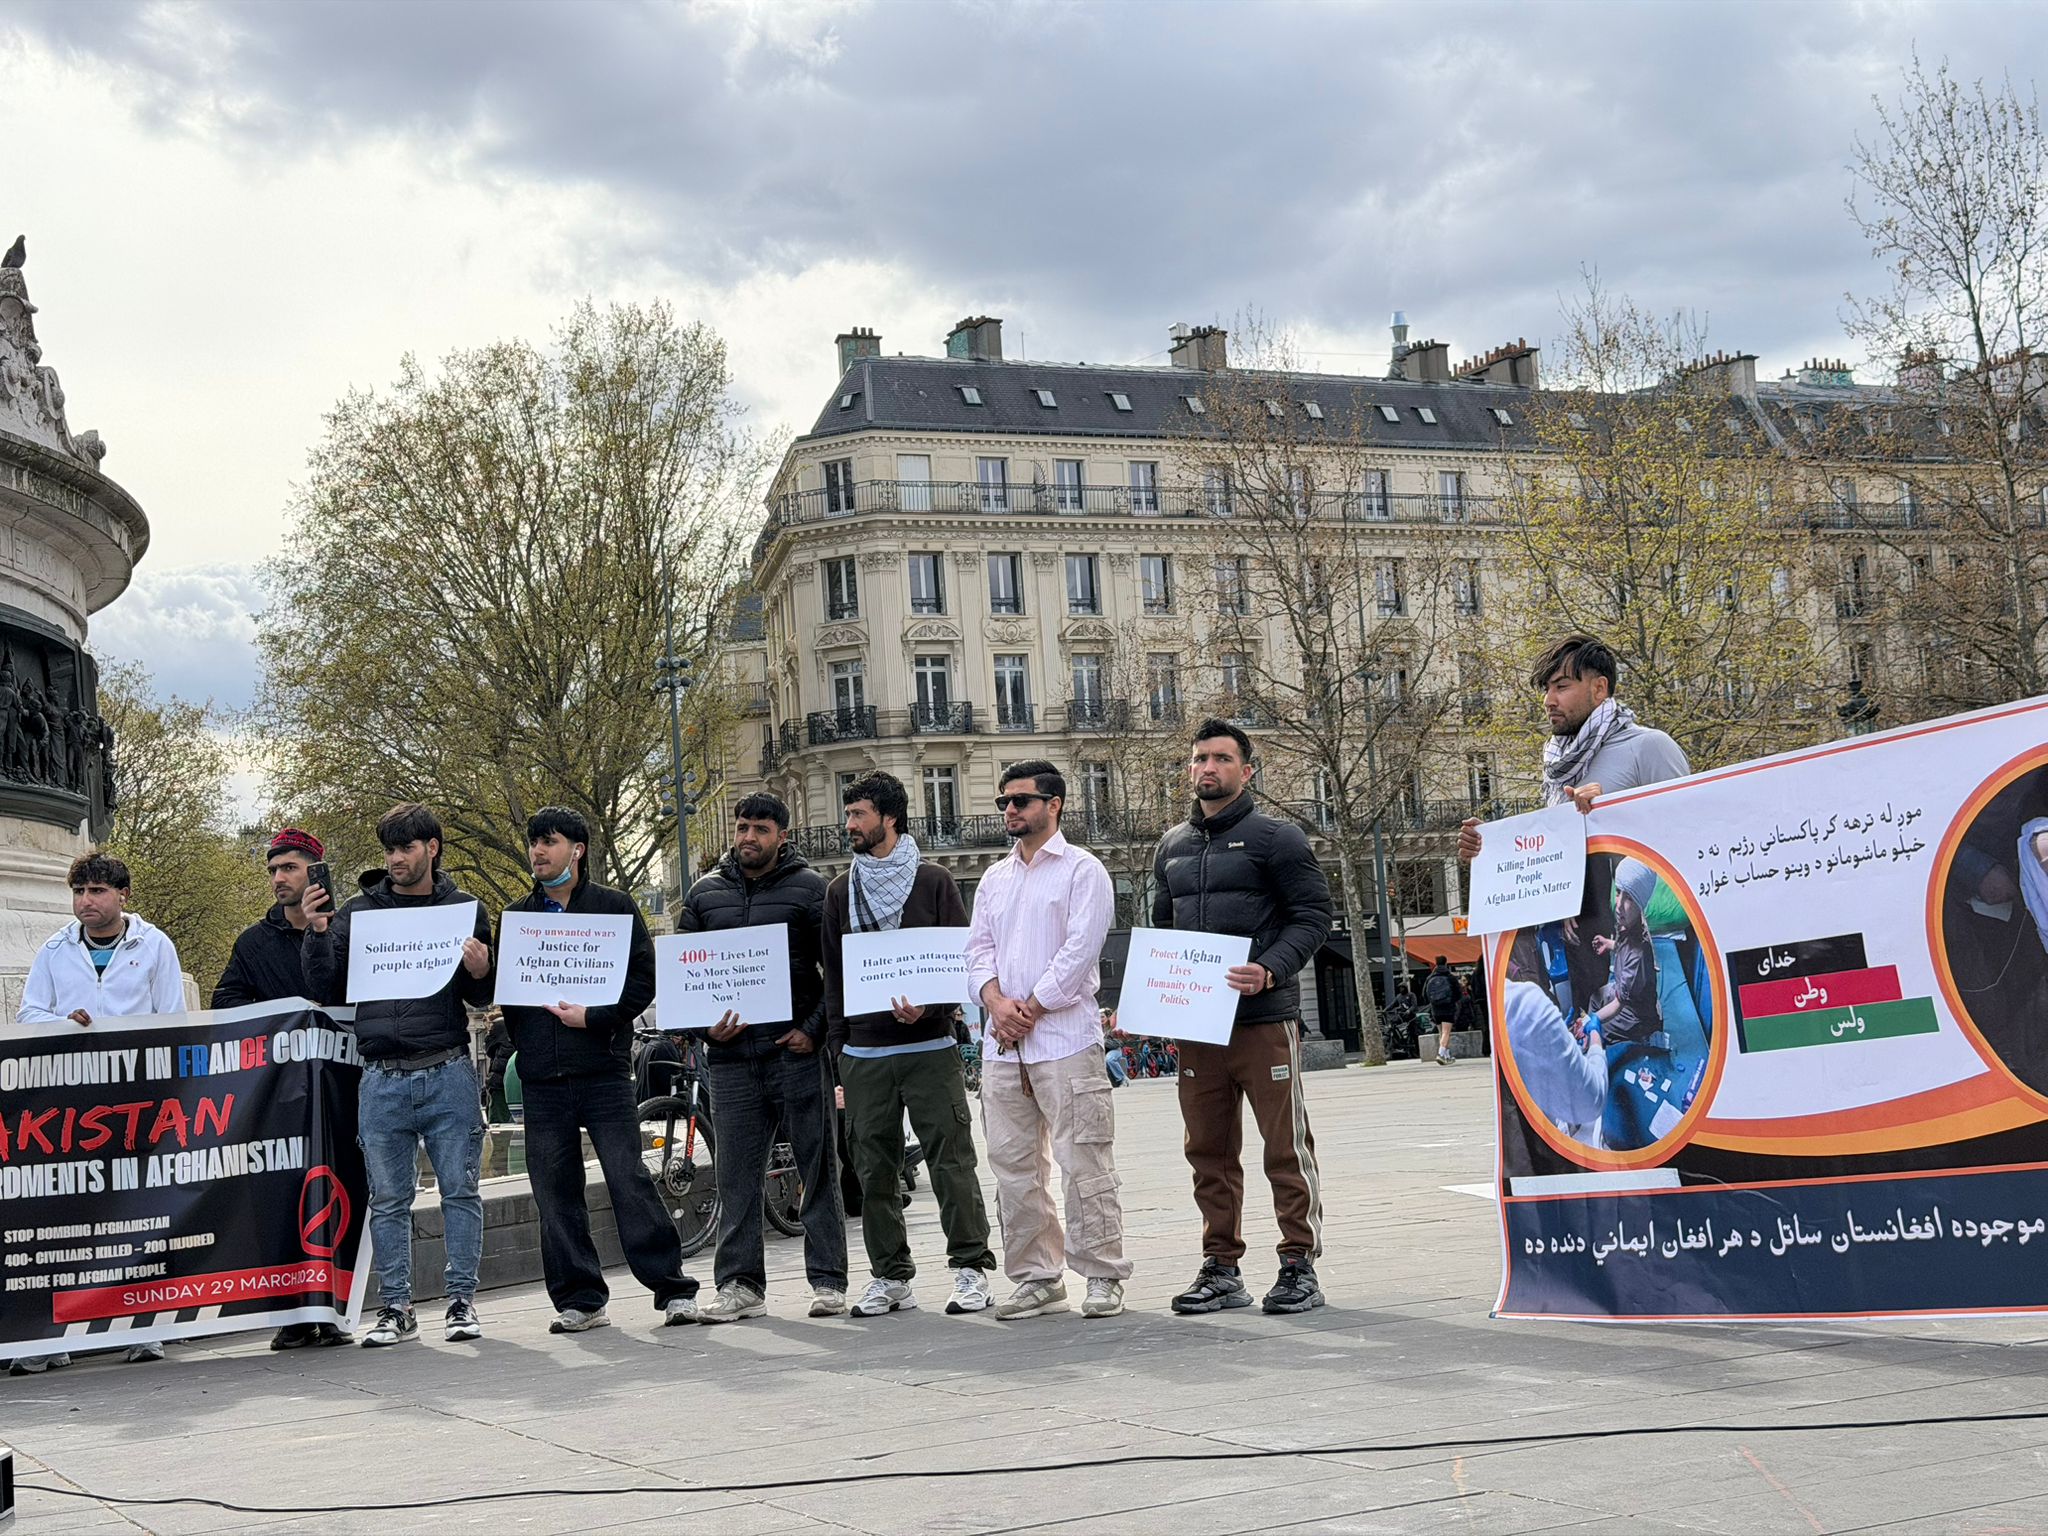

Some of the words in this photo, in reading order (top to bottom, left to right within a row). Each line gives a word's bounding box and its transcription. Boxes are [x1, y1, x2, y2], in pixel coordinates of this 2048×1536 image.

[1880, 802, 1892, 823] له
[1514, 834, 1545, 852] Stop
[1709, 843, 1720, 856] نه
[1892, 834, 1926, 862] خپلو
[1497, 861, 1524, 874] Killing
[1527, 851, 1563, 867] Innocent
[1698, 850, 1704, 859] د
[1827, 840, 1887, 873] ماشومانو
[1815, 859, 1822, 869] د
[1516, 870, 1543, 885] People
[1735, 862, 1779, 888] حساب
[1485, 892, 1516, 906] Afghan
[1518, 887, 1540, 899] Lives
[1542, 880, 1572, 895] Matter
[520, 926, 542, 938] Stop
[545, 928, 591, 938] unwanted
[594, 930, 616, 938] wars
[365, 941, 423, 954] Solidarité
[426, 940, 451, 950] avec
[453, 937, 462, 946] le
[538, 941, 579, 953] Justice
[583, 942, 601, 953] for
[372, 959, 413, 973] peuple
[416, 956, 453, 970] afghan
[516, 956, 560, 969] Afghan
[564, 957, 614, 969] Civilians
[678, 949, 717, 964] 400+
[721, 951, 745, 961] Lives
[749, 948, 769, 958] Lost
[863, 958, 893, 968] Halte
[896, 955, 916, 963] aux
[1150, 948, 1178, 960] Protect
[1180, 949, 1222, 964] Afghan
[1757, 947, 1796, 976] خدای
[520, 972, 532, 982] in
[536, 973, 606, 986] Afghanistan
[687, 969, 701, 979] No
[704, 967, 729, 977] More
[732, 964, 766, 975] Silence
[860, 971, 896, 982] contre
[899, 968, 913, 977] les
[1169, 965, 1192, 976] Lives
[684, 982, 704, 992] End
[708, 981, 723, 990] the
[725, 977, 766, 989] Violence
[1147, 977, 1187, 992] Humanity
[1189, 981, 1213, 993] Over
[1794, 976, 1828, 1008] وطن
[712, 994, 733, 1003] Now
[1160, 993, 1190, 1005] Politics
[1830, 1005, 1865, 1037] ولس
[145, 1046, 172, 1080] IN
[178, 1035, 268, 1078] FRANCE
[0, 1159, 105, 1200] DMENTS
[112, 1157, 139, 1191] IN
[145, 1136, 303, 1189] AFGHANISTAN
[4, 1229, 34, 1244] STOP
[37, 1224, 91, 1241] BOMBING
[94, 1216, 170, 1236] AFGHANISTAN
[1769, 1213, 1822, 1256] ساتل
[1831, 1206, 1944, 1252] افغانستان
[1951, 1217, 2046, 1247] موجوده
[1525, 1237, 1545, 1254] ده
[1550, 1232, 1586, 1254] دنده
[1661, 1218, 1714, 1258] افغان
[1719, 1229, 1743, 1258] هر
[1750, 1230, 1762, 1247] د
[4, 1253, 33, 1267] 400+
[35, 1247, 93, 1264] CIVILIANS
[95, 1244, 132, 1259] KILLED
[144, 1239, 167, 1254] 200
[169, 1232, 215, 1251] INJURED
[5, 1276, 50, 1291] JUSTICE
[53, 1273, 75, 1287] FOR
[78, 1268, 122, 1284] AFGHAN
[125, 1263, 167, 1279] PEOPLE
[123, 1282, 204, 1306] SUNDAY
[211, 1279, 235, 1295] 29
[240, 1272, 297, 1291] MARCH
